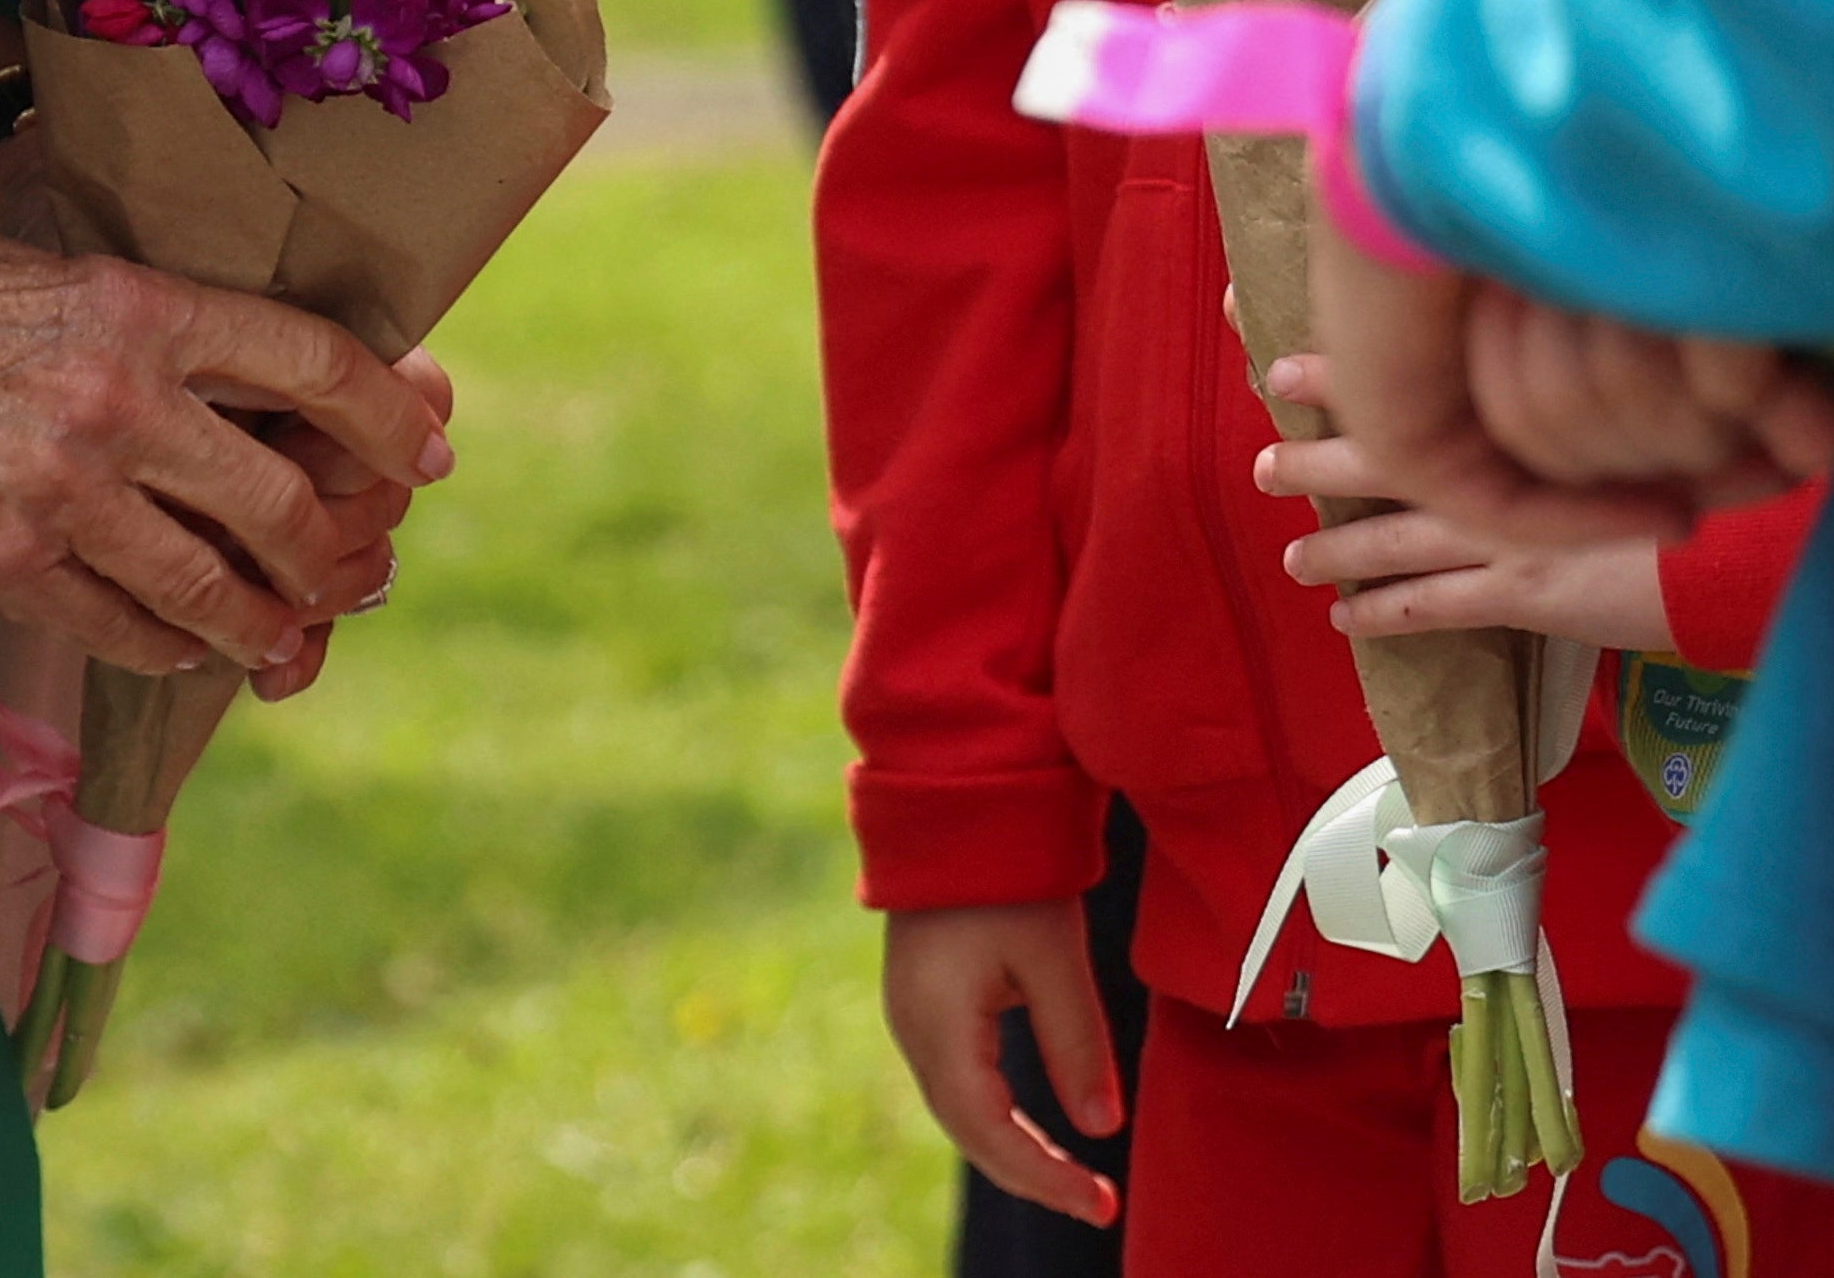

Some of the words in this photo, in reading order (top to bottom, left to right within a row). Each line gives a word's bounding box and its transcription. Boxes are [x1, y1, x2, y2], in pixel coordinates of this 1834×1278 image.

[1654, 689, 1682, 707] Our
[1688, 695, 1739, 718] Thrivin
[1666, 712, 1719, 734] Future
